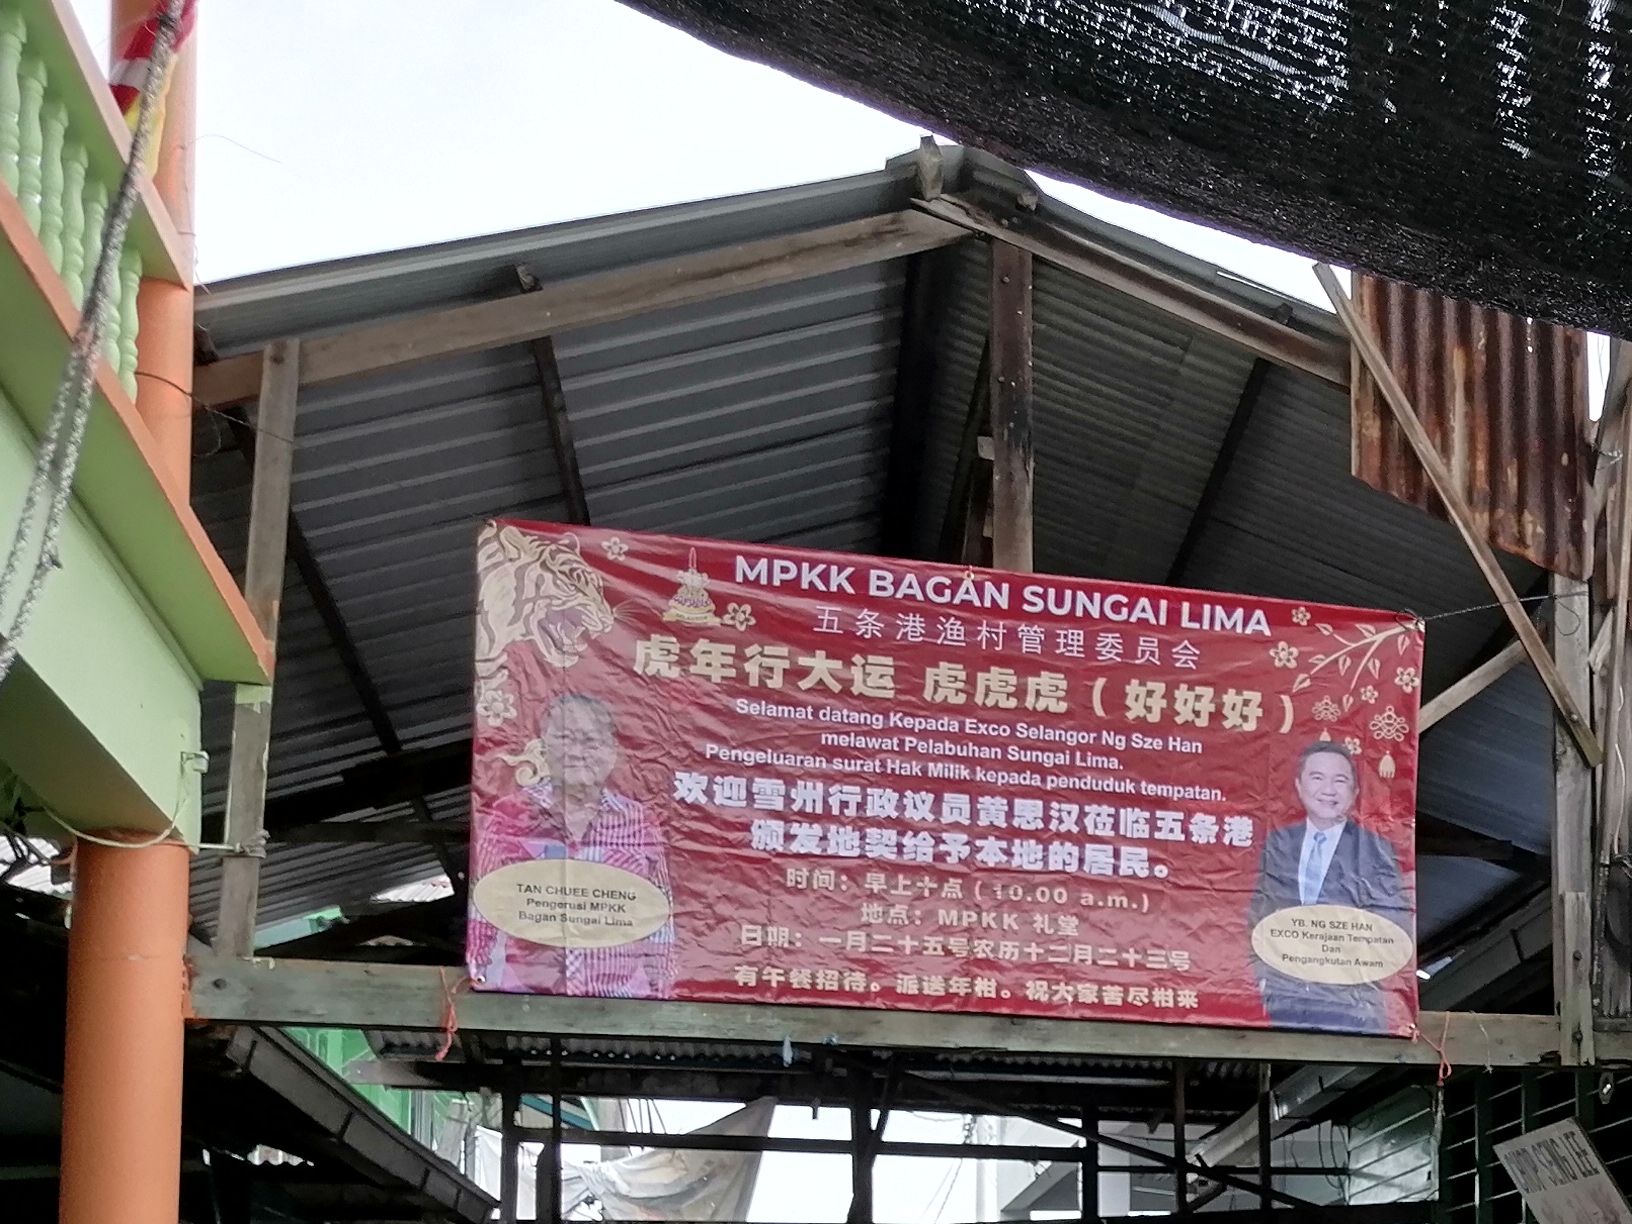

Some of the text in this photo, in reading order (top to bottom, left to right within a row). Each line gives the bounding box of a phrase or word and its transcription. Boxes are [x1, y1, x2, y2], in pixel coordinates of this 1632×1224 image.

[735, 555, 1272, 637] MPKK BAGAN SUNGAI LIMA
[813, 605, 1201, 670] 五条港渔村管理委员会
[632, 633, 896, 699] 虎年行大运
[736, 698, 1202, 754] Selamat datang Kepada Exco Selangor Ng Sze Han
[821, 732, 1124, 770] melawat Pelabuhan Sungai Lima.
[705, 743, 1227, 802] Pengeluaran surat Hak Milik kepada penduduk tempatan.
[750, 818, 1170, 879] 颁发地契给予本地的居民。
[516, 883, 542, 895] TAN
[592, 889, 637, 901] CHENG
[526, 898, 626, 914] Pengerusi MPKK
[518, 910, 634, 928] Bagan Sungai Lima
[1270, 928, 1395, 945] EXCO Kerajaan Tempatan
[1311, 920, 1326, 929] NG
[1329, 921, 1348, 930] SZE
[1350, 922, 1374, 932] HAN
[1281, 953, 1384, 969] Pengangkutan Awam
[1321, 944, 1341, 954] Dan
[1557, 1130, 1600, 1178] LEE
